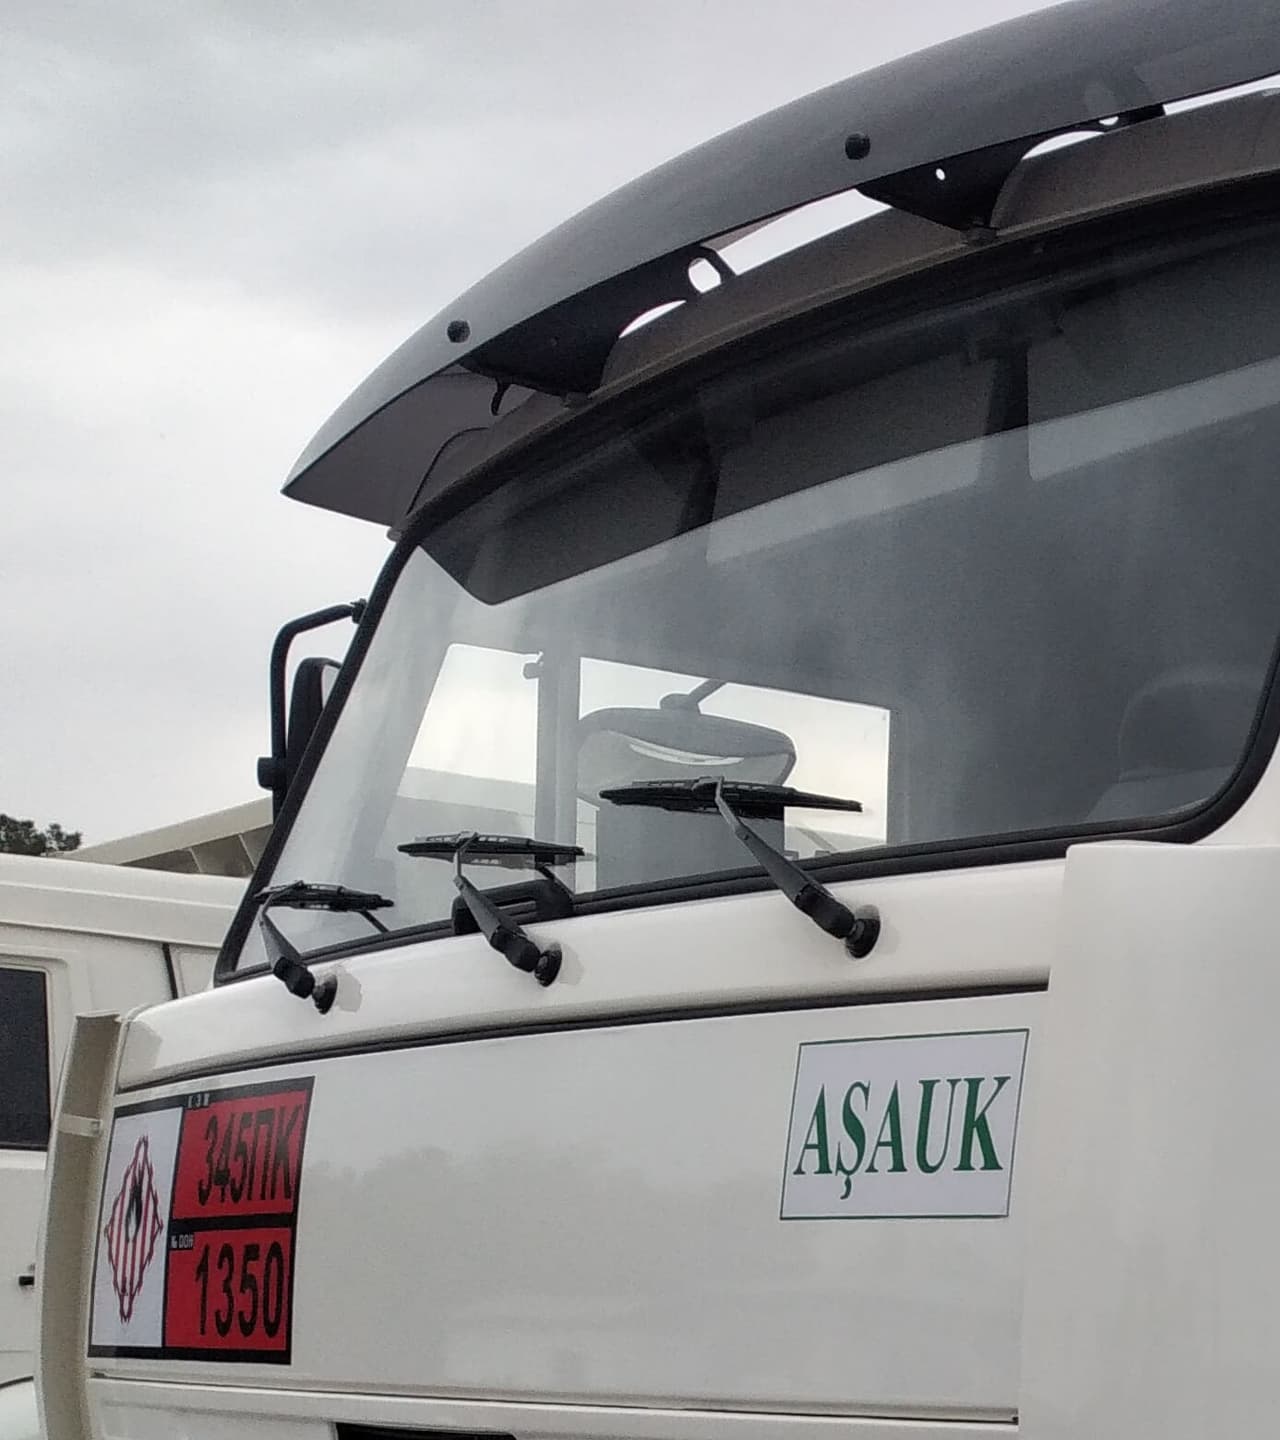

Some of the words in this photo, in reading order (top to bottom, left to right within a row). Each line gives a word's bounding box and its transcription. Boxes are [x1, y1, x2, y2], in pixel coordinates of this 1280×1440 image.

[198, 1105, 300, 1206] 345ПК
[793, 1076, 1012, 1200] AŞAUK
[194, 1241, 284, 1338] 1350
